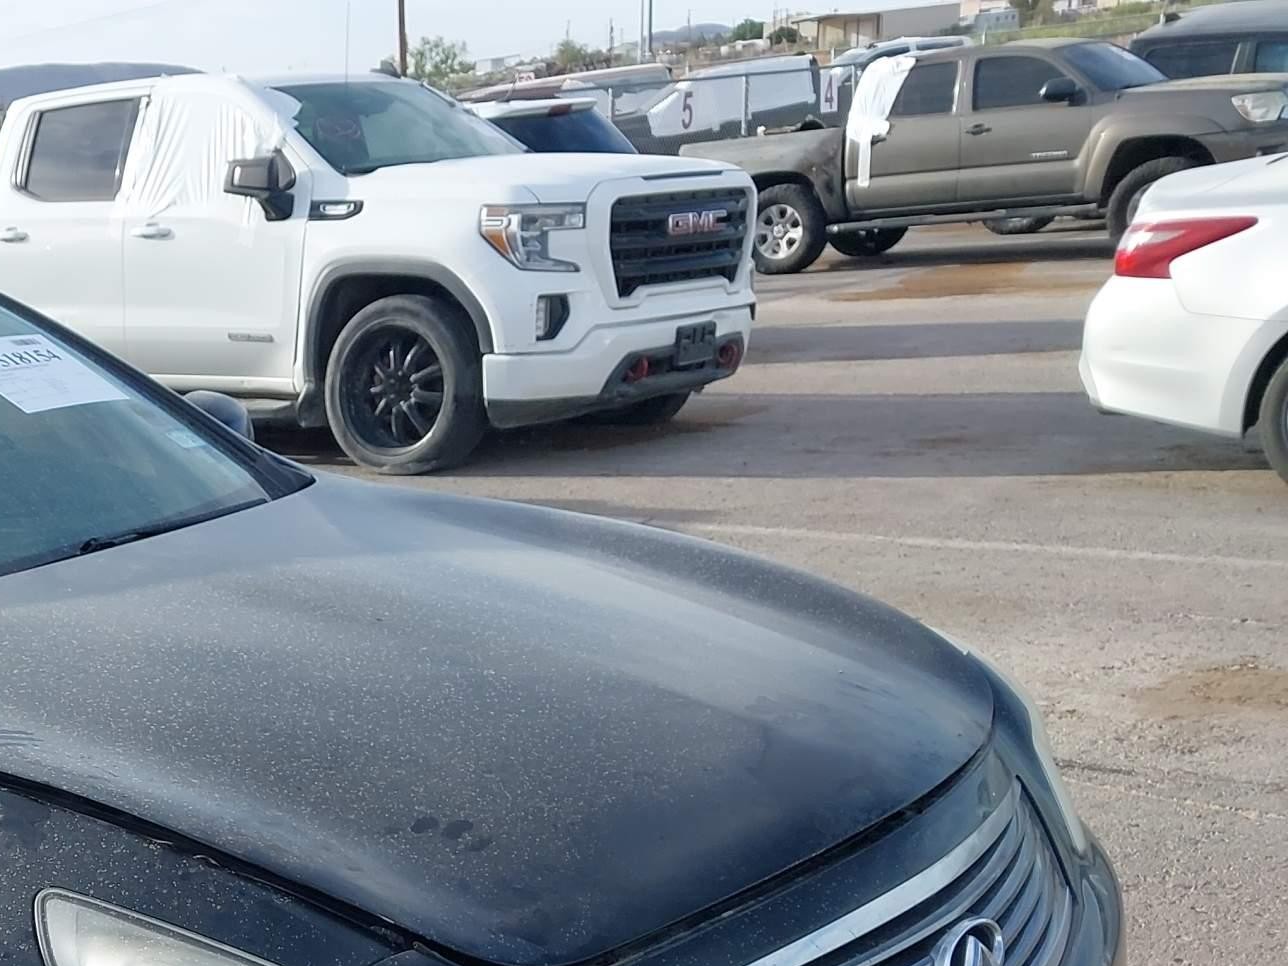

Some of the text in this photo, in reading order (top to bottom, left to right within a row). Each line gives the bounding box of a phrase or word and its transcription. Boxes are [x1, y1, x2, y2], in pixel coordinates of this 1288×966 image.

[681, 90, 693, 129] 5
[824, 74, 834, 110] 4
[668, 209, 728, 235] GMC
